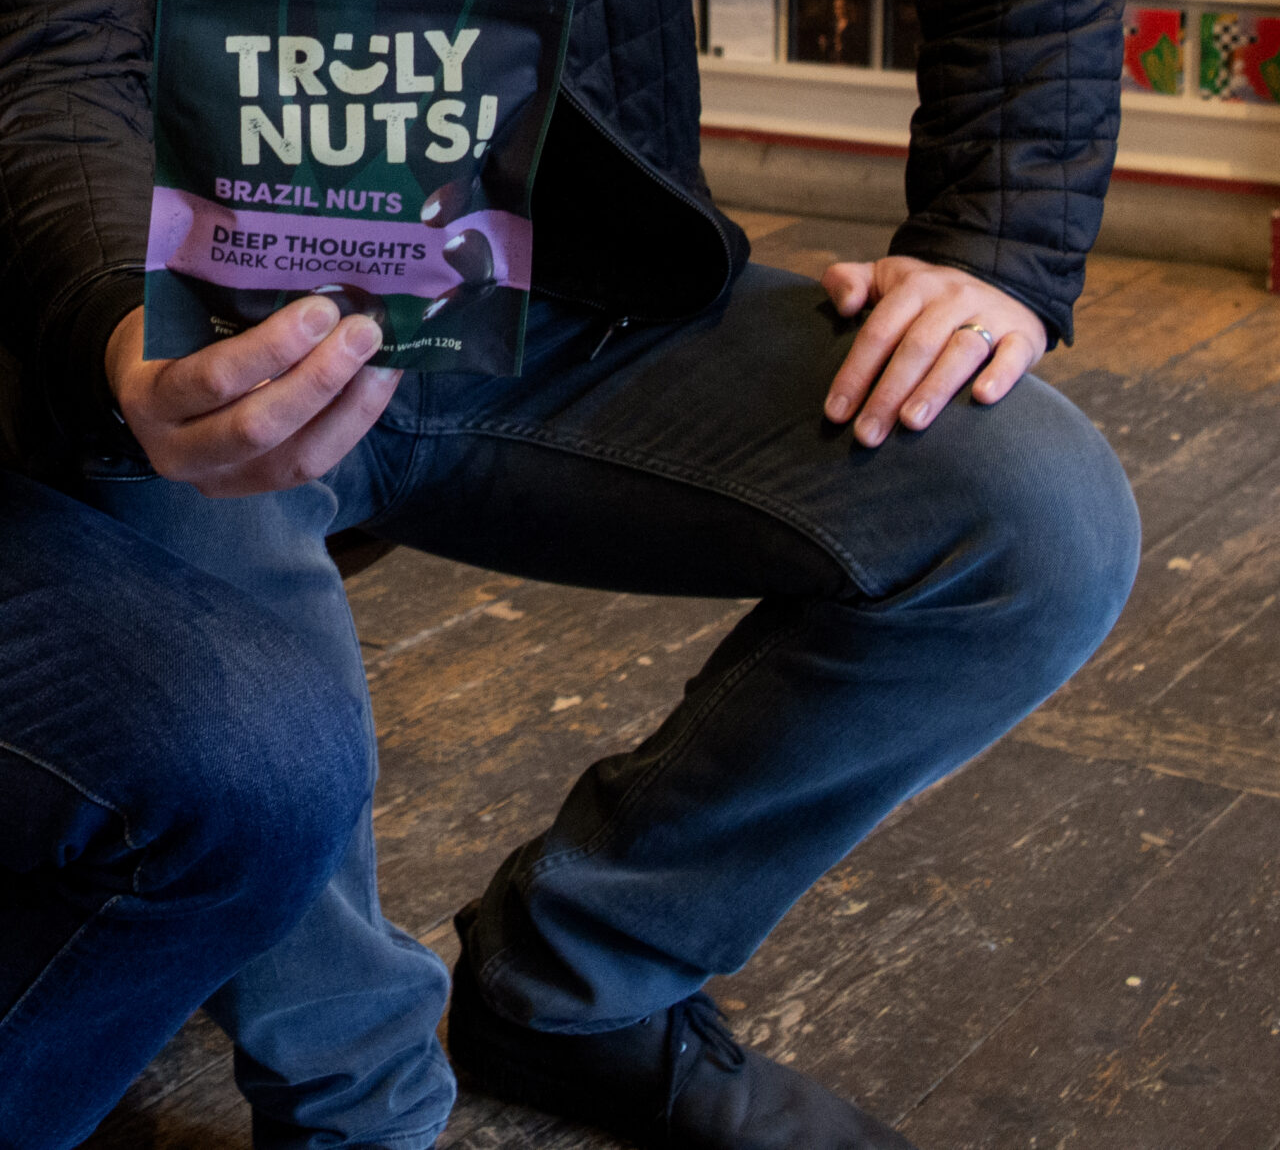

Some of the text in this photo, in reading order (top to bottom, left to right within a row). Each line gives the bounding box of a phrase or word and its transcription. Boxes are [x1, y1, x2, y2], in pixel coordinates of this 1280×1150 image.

[240, 95, 498, 167] NUTS!
[215, 177, 403, 215] BRAZIL NUTS
[212, 224, 427, 260] DEEP THOUGHTS
[210, 247, 406, 277] DARK CHOCOLATE
[435, 337, 462, 351] 120g
